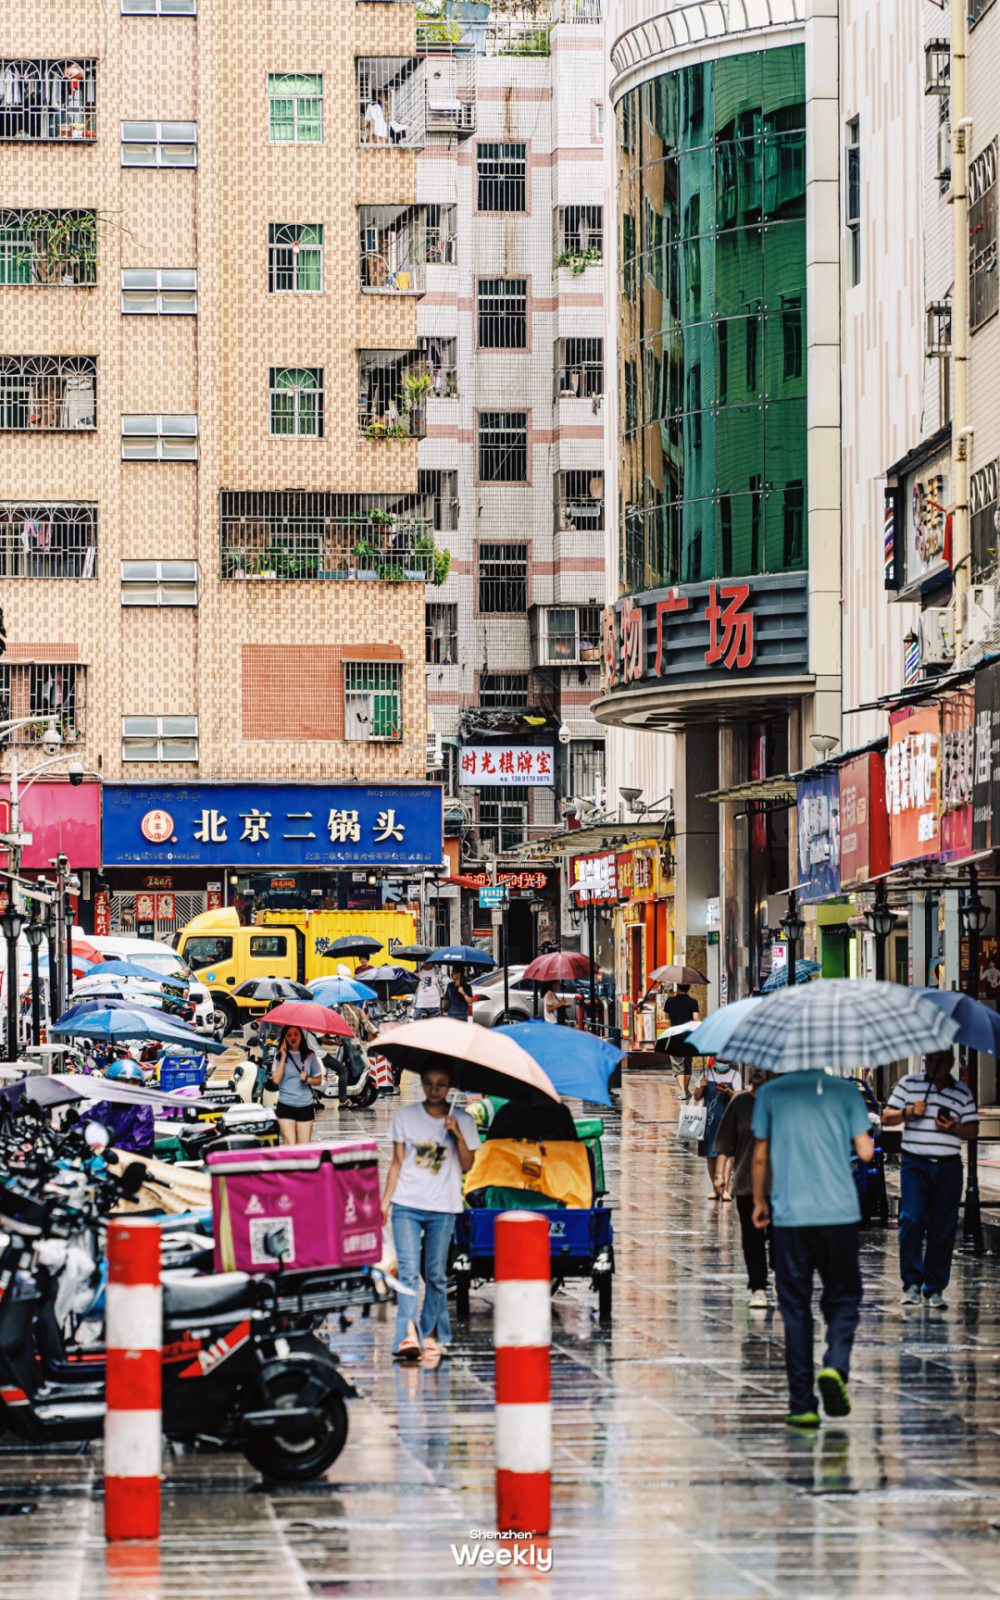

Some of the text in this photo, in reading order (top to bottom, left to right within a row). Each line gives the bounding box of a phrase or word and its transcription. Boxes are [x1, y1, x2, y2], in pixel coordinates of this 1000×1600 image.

[461, 750, 552, 776] 时光棋牌室
[193, 808, 406, 843] 北京二锅头
